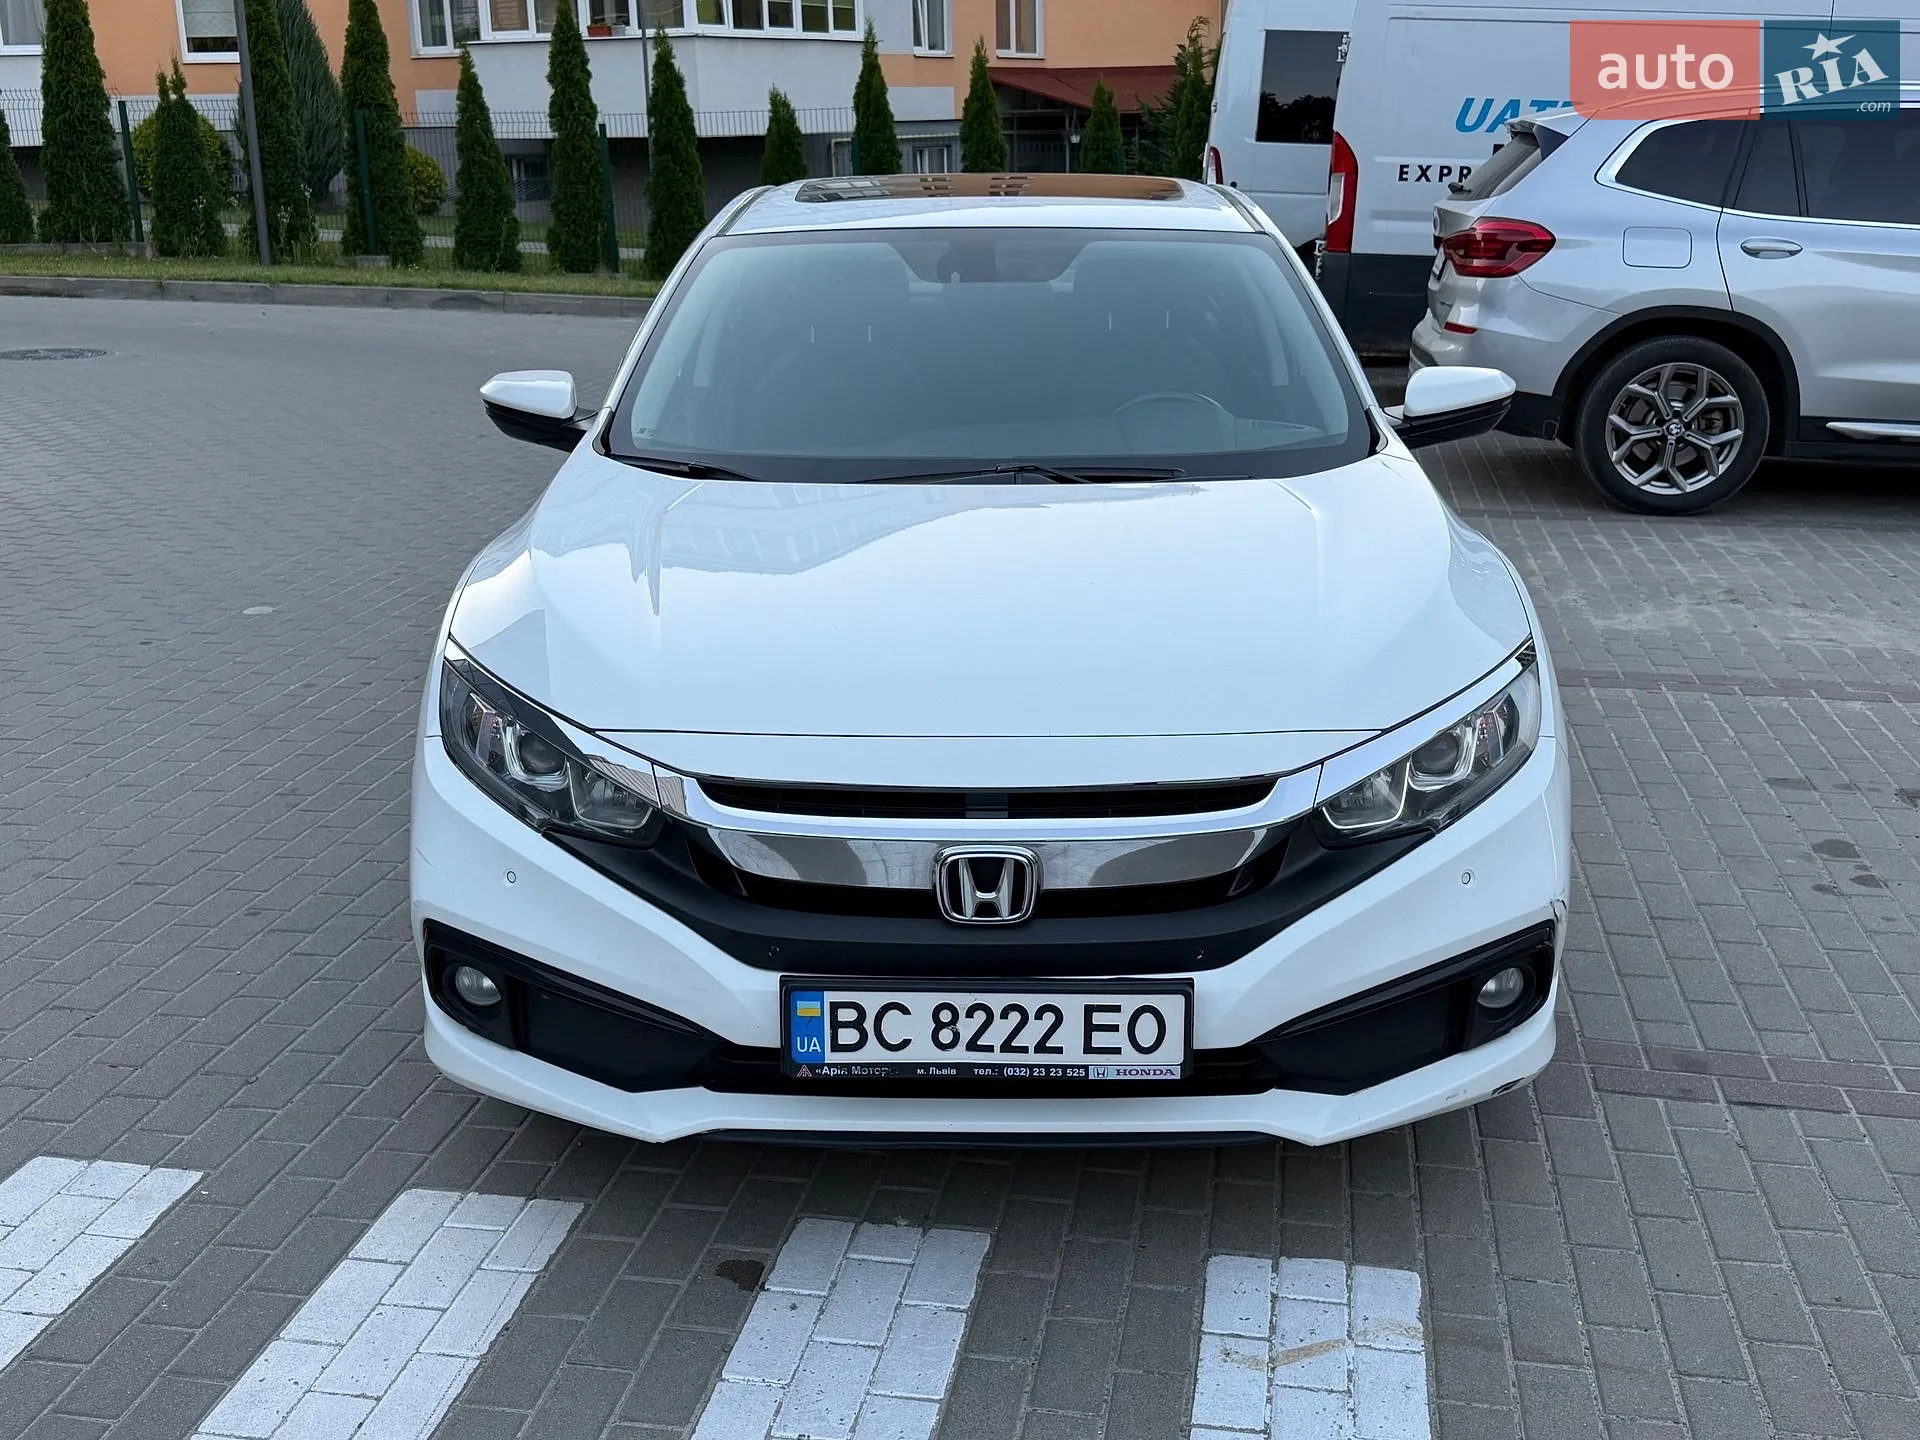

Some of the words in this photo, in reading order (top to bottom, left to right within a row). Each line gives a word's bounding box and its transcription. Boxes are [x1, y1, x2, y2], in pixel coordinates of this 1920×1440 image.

[829, 1000, 912, 1053] BC
[930, 1001, 1064, 1055] 8222
[1082, 1003, 1167, 1055] EO
[796, 1036, 821, 1053] UA
[928, 1066, 957, 1076] Львів
[1003, 1066, 1030, 1078] (032)
[1032, 1068, 1046, 1077] 23
[1049, 1068, 1063, 1077] 23
[1066, 1068, 1086, 1077] 525
[1115, 1068, 1177, 1077] HONDA
